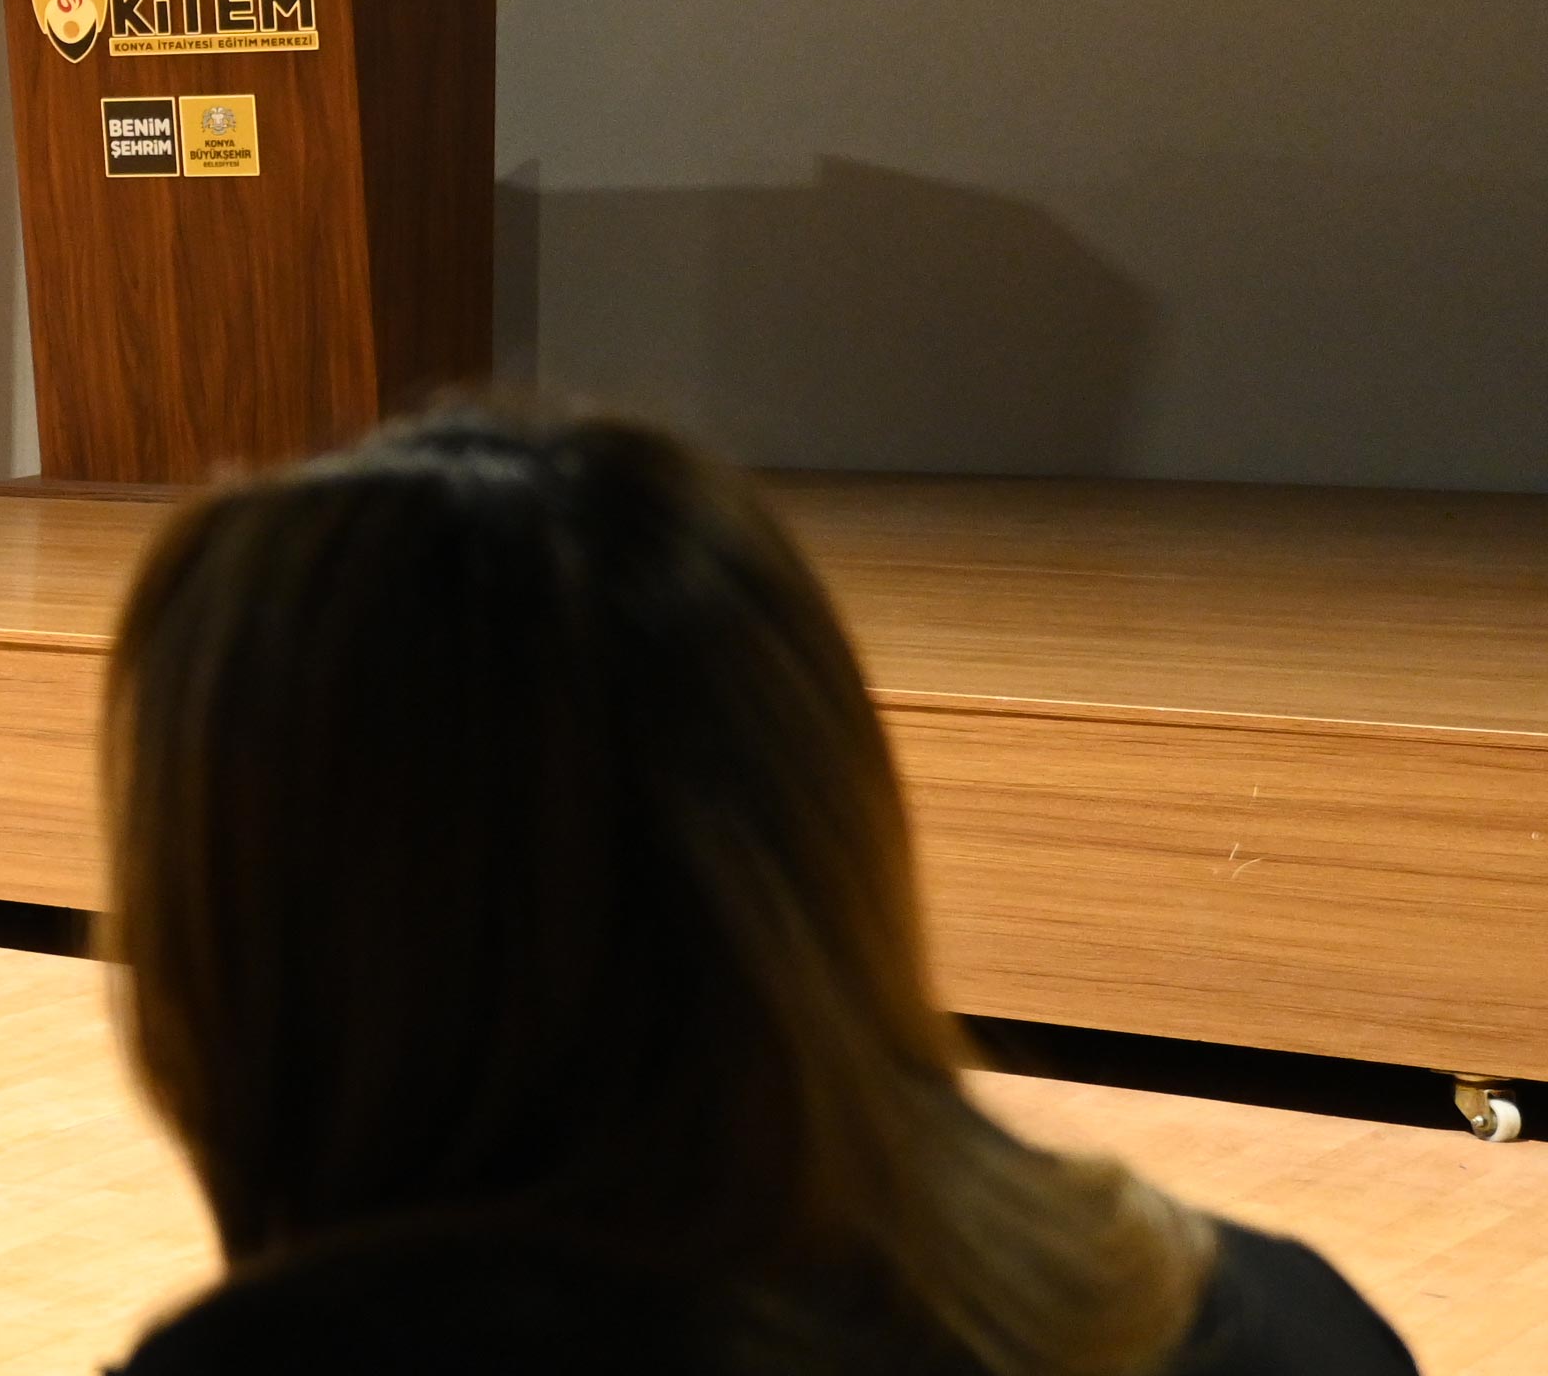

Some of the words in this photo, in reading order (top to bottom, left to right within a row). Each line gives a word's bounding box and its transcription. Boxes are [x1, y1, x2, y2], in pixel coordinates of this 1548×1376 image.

[114, 42, 154, 52] KONYA
[157, 39, 213, 51] İTFAİYESİ
[218, 37, 257, 49] EĞİTİM
[260, 36, 313, 47] MERKEZİ
[108, 118, 171, 137] BENİM
[110, 139, 173, 158] ŞEHRİM
[205, 139, 235, 148] KONYA
[190, 148, 251, 161] BÜYÜKŞEHİR
